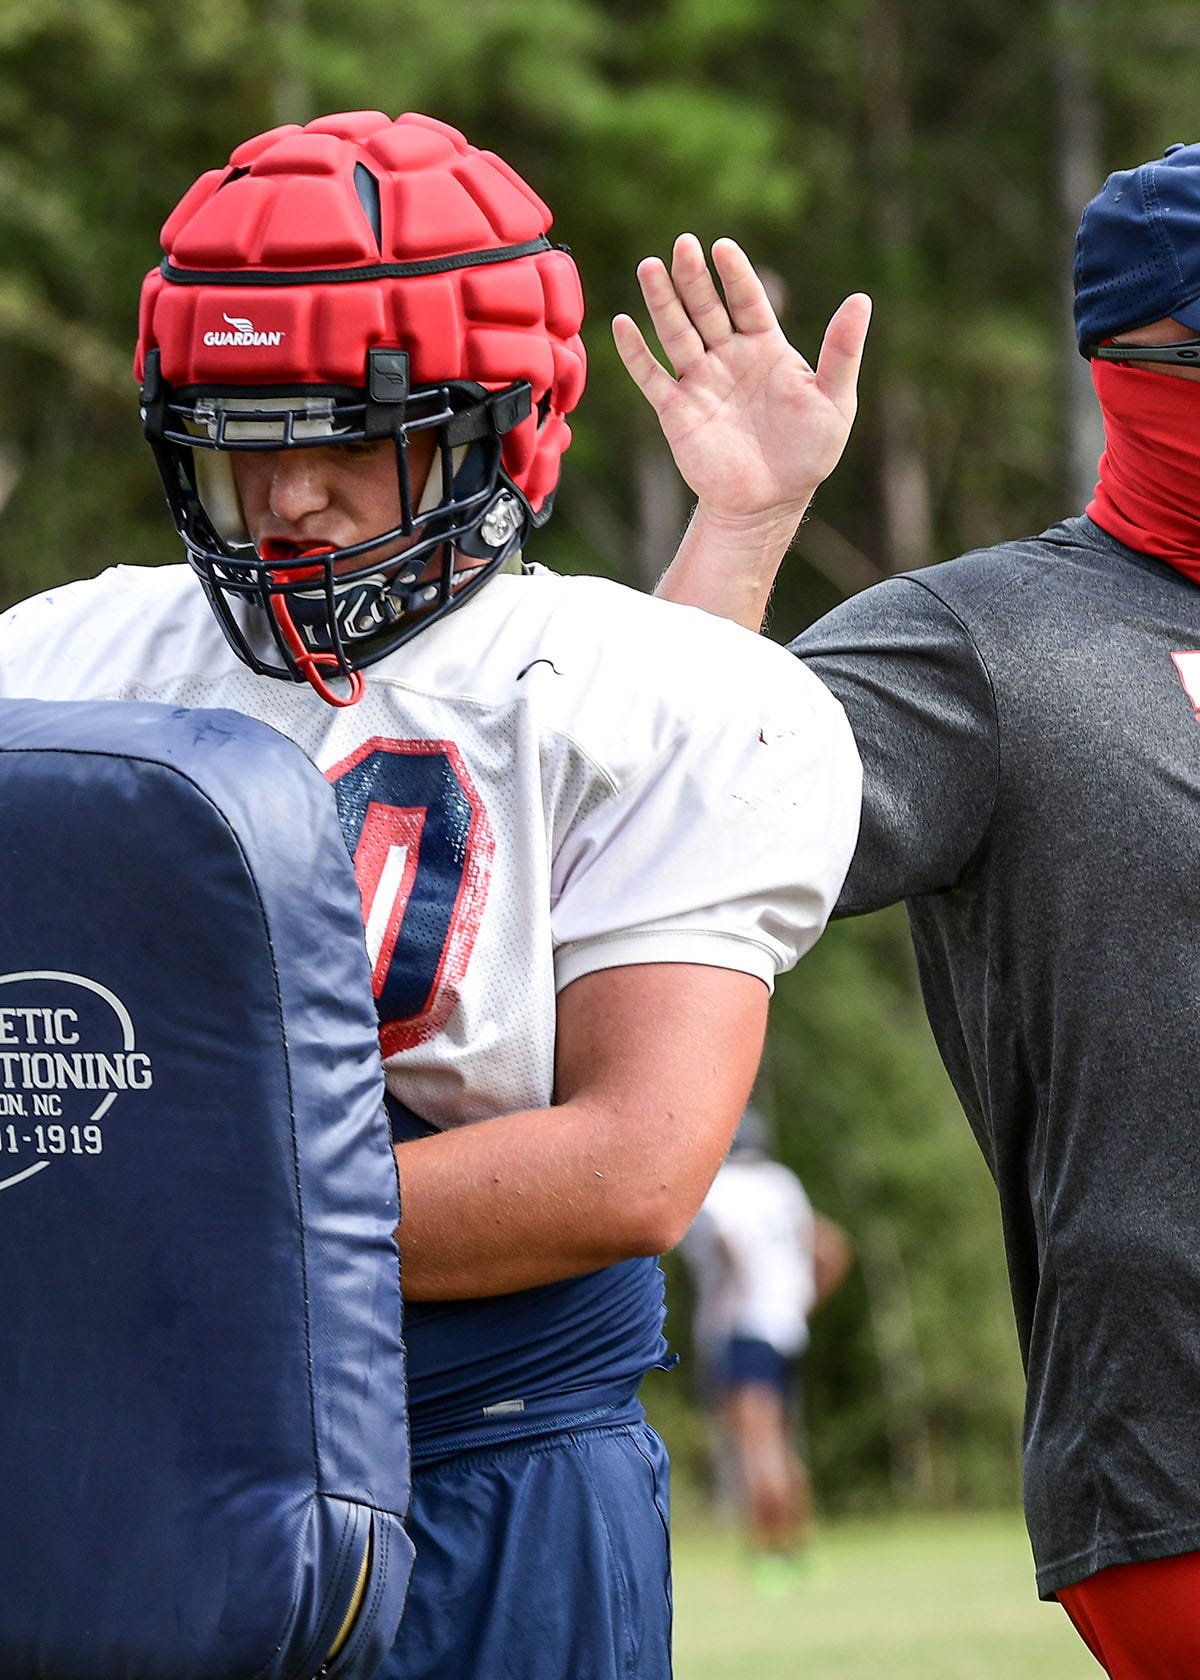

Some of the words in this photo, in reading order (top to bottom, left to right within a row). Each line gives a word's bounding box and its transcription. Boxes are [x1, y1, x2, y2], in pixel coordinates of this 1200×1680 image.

[203, 331, 281, 346] GUARDIAN
[0, 1008, 80, 1045] ETIC
[32, 1094, 62, 1116] NC
[0, 1124, 103, 1154] 1-1919
